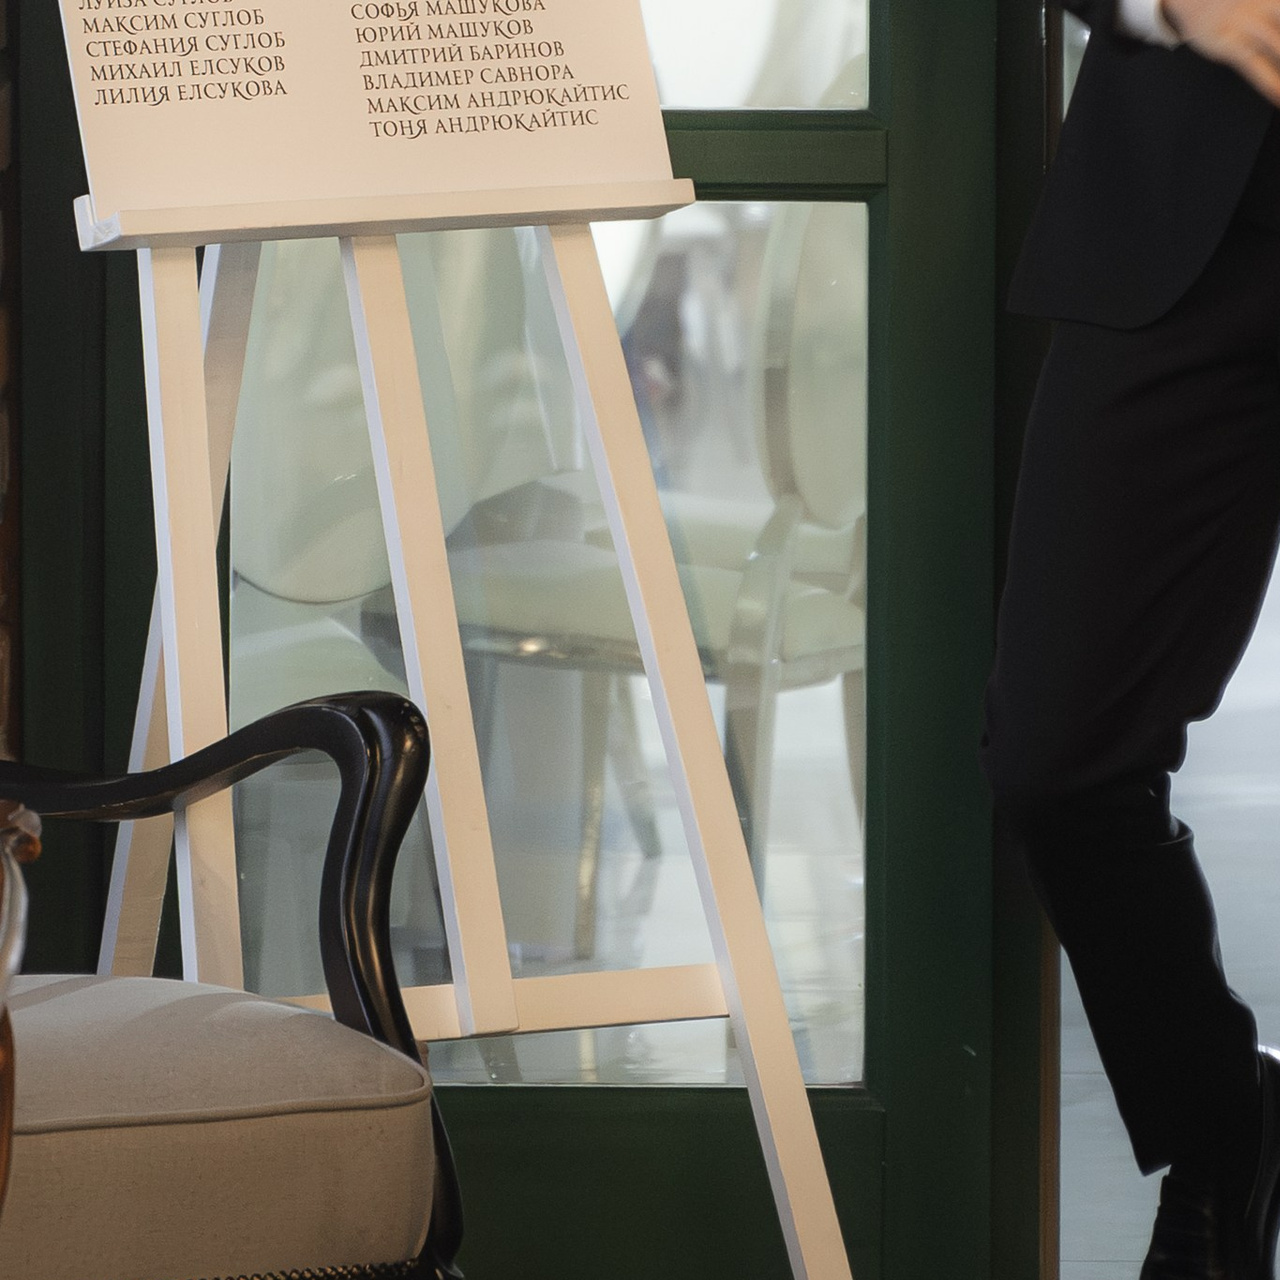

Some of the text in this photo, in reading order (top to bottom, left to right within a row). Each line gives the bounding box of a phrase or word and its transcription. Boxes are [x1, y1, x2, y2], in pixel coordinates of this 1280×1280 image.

[82, 9, 265, 35] МАКСИМ СУГЛОБ
[350, 1, 419, 21] СОФЬЯ
[85, 31, 286, 57] СТЕФАНИЯ СУГЛОБ
[355, 19, 534, 44] ЮРИЙ МАШУКОВ
[359, 40, 564, 68] ДМИТРИЙ БАРИНОВ
[90, 55, 285, 82] МИХАИЛ ЕЛСУКОВ
[94, 79, 288, 106] ЛИЛИЯ ЕЛСУКОВА
[366, 83, 630, 115] МАКСИМ АНДРЮКАЙТИС
[369, 108, 599, 139] ТОНЯ АНДРЮКАЙТИС
